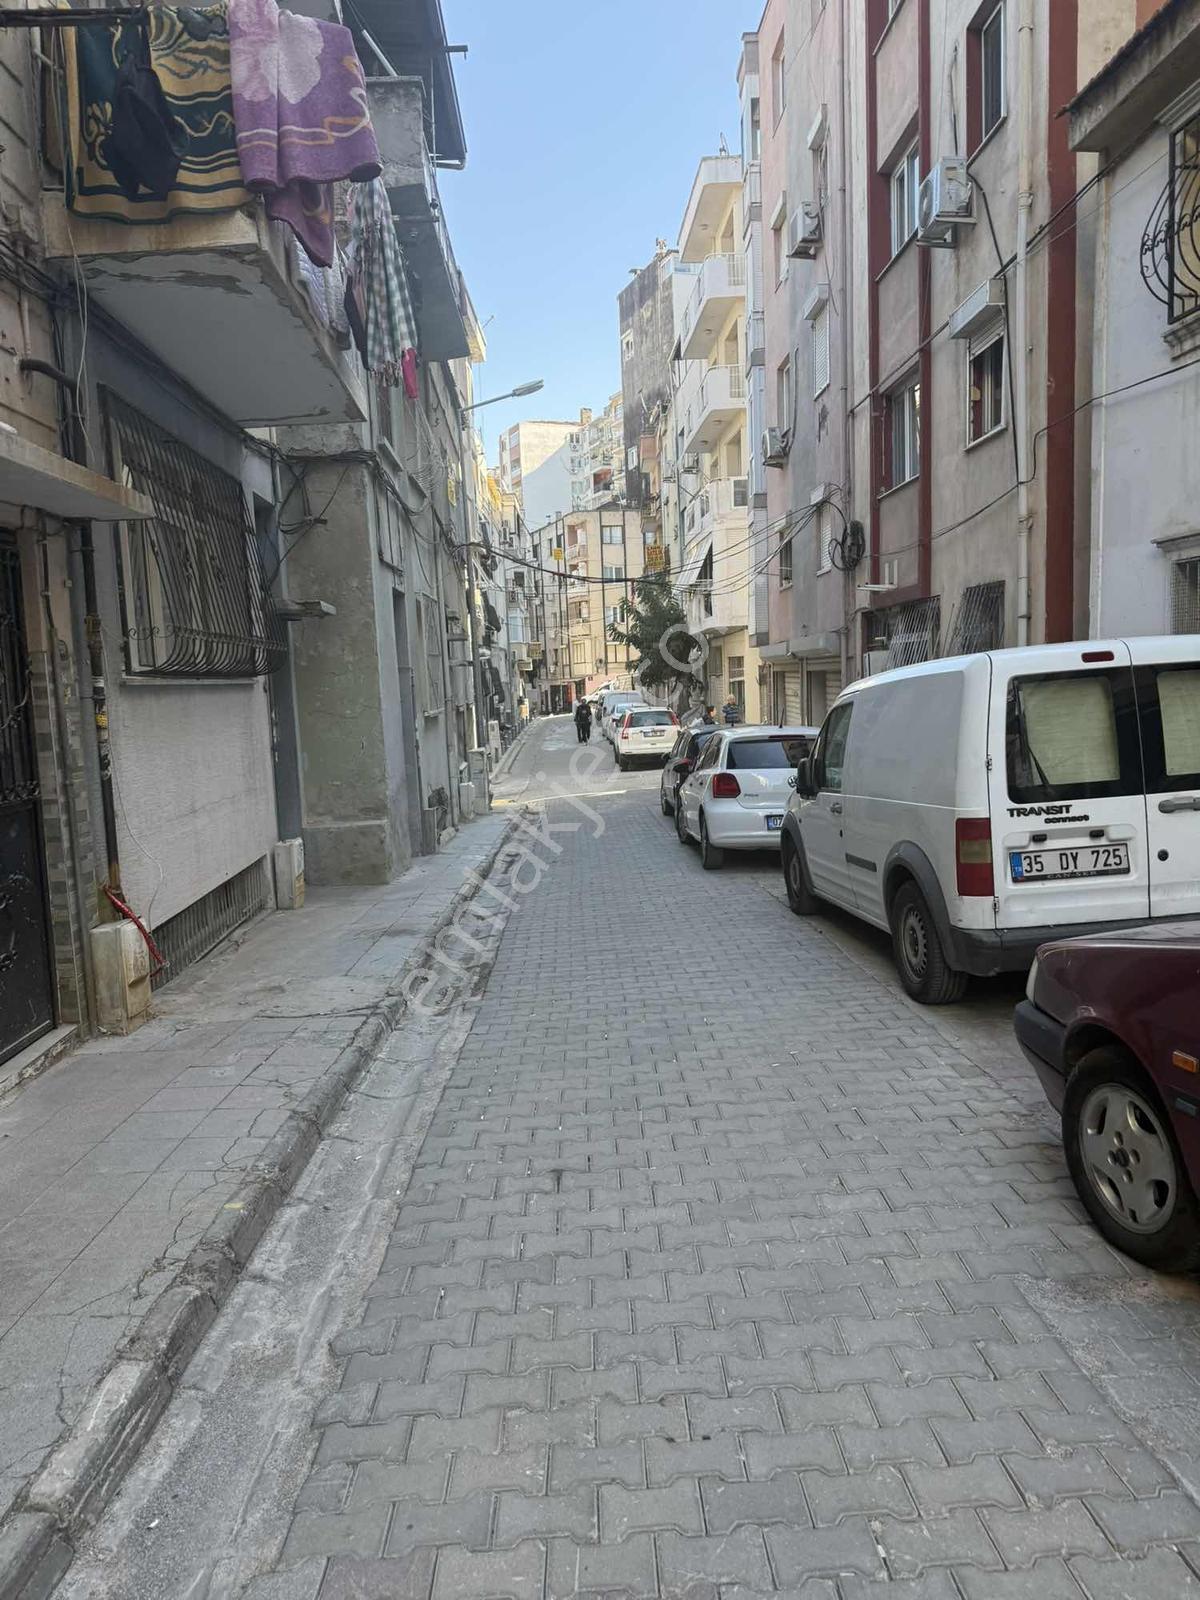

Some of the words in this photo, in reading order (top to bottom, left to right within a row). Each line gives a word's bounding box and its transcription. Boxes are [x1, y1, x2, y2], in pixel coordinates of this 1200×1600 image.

[1007, 804, 1073, 818] TRANSIT
[1044, 814, 1090, 824] connect
[1023, 855, 1044, 873] 35
[1059, 851, 1079, 871] DY
[1091, 848, 1123, 868] 725
